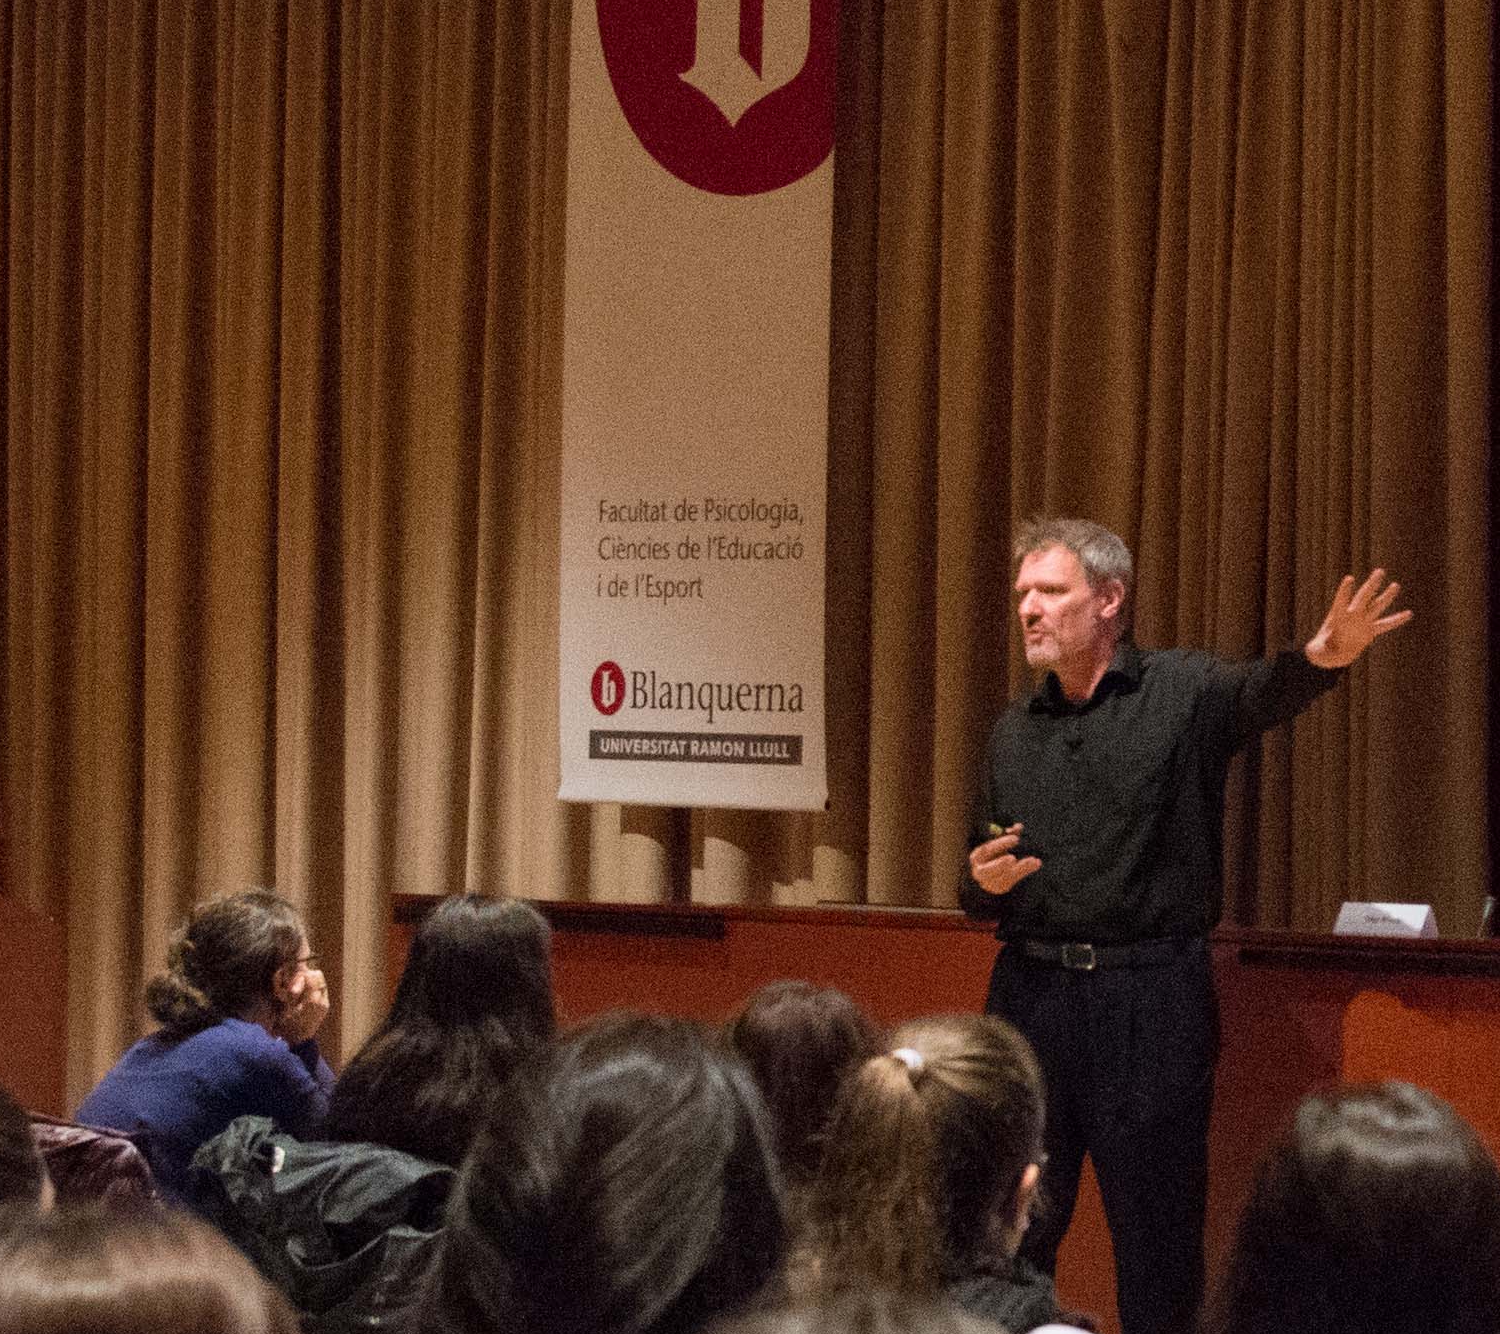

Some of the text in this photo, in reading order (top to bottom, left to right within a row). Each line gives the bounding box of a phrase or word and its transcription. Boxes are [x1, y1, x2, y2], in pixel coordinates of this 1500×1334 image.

[599, 497, 804, 529] Facultat de Psicologia,
[598, 534, 804, 562] Ciències de l'Educació
[596, 573, 704, 606] i de l'Esport
[629, 670, 805, 725] Blanquerna
[599, 737, 790, 759] UNIVERSITAT RAMON LLULL
